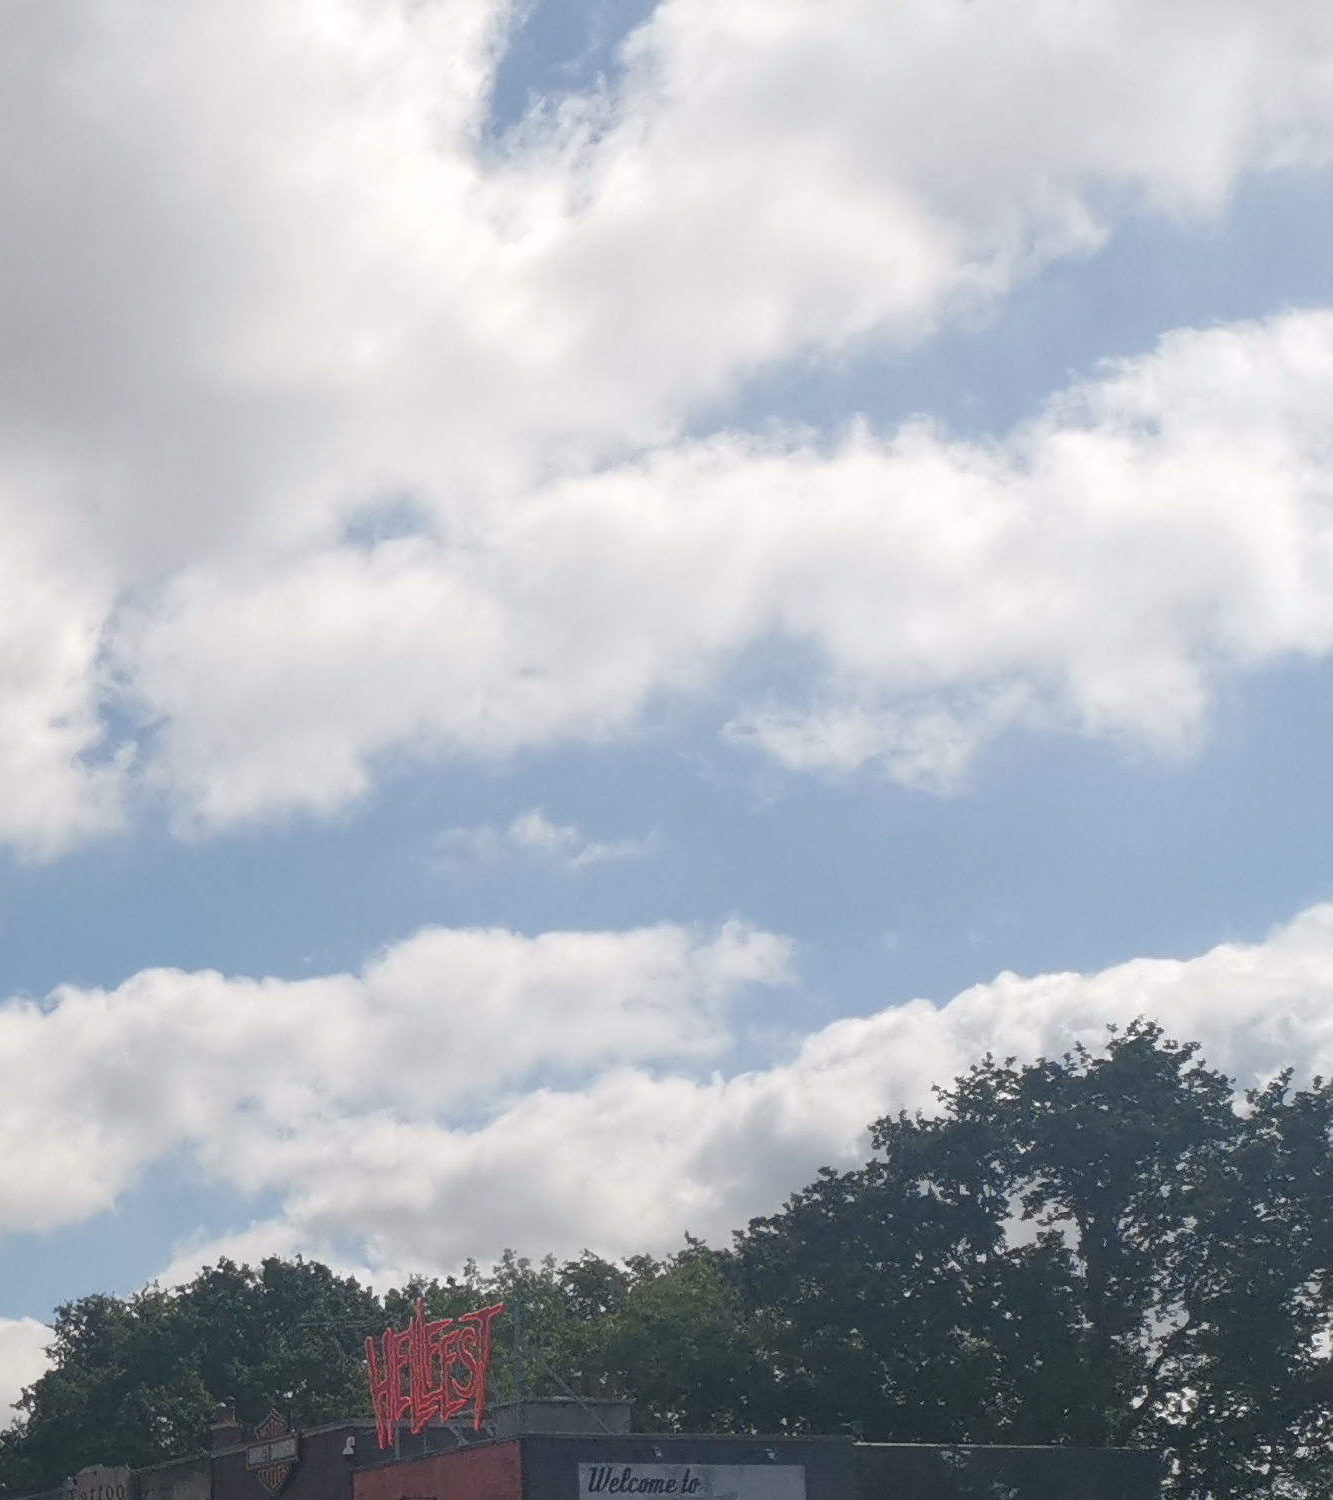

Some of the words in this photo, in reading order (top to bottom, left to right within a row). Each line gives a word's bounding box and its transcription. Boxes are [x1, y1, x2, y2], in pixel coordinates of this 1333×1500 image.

[365, 1297, 505, 1449] HELLFEST
[588, 1467, 678, 1494] Welcome
[681, 1468, 700, 1494] to
